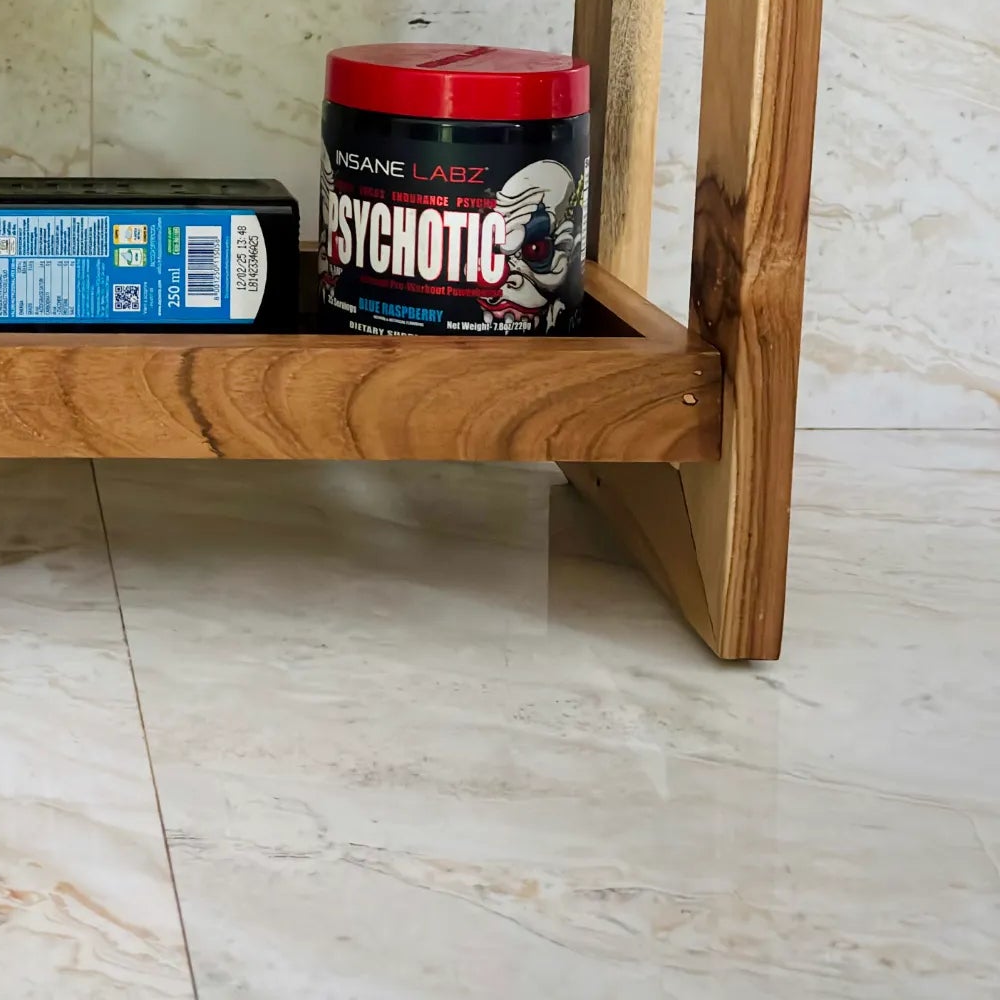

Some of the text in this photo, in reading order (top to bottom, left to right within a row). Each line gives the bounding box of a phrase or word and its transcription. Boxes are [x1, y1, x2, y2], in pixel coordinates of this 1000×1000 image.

[336, 149, 405, 178] INSANE
[327, 190, 506, 284] PSYCHOTIC
[168, 268, 180, 283] ml
[236, 253, 247, 291] 12/02/25
[168, 285, 180, 308] 250
[359, 297, 380, 313] BLUE
[381, 302, 443, 322] RASPBERRY
[349, 320, 384, 336] DIETARY
[447, 321, 460, 330] Net
